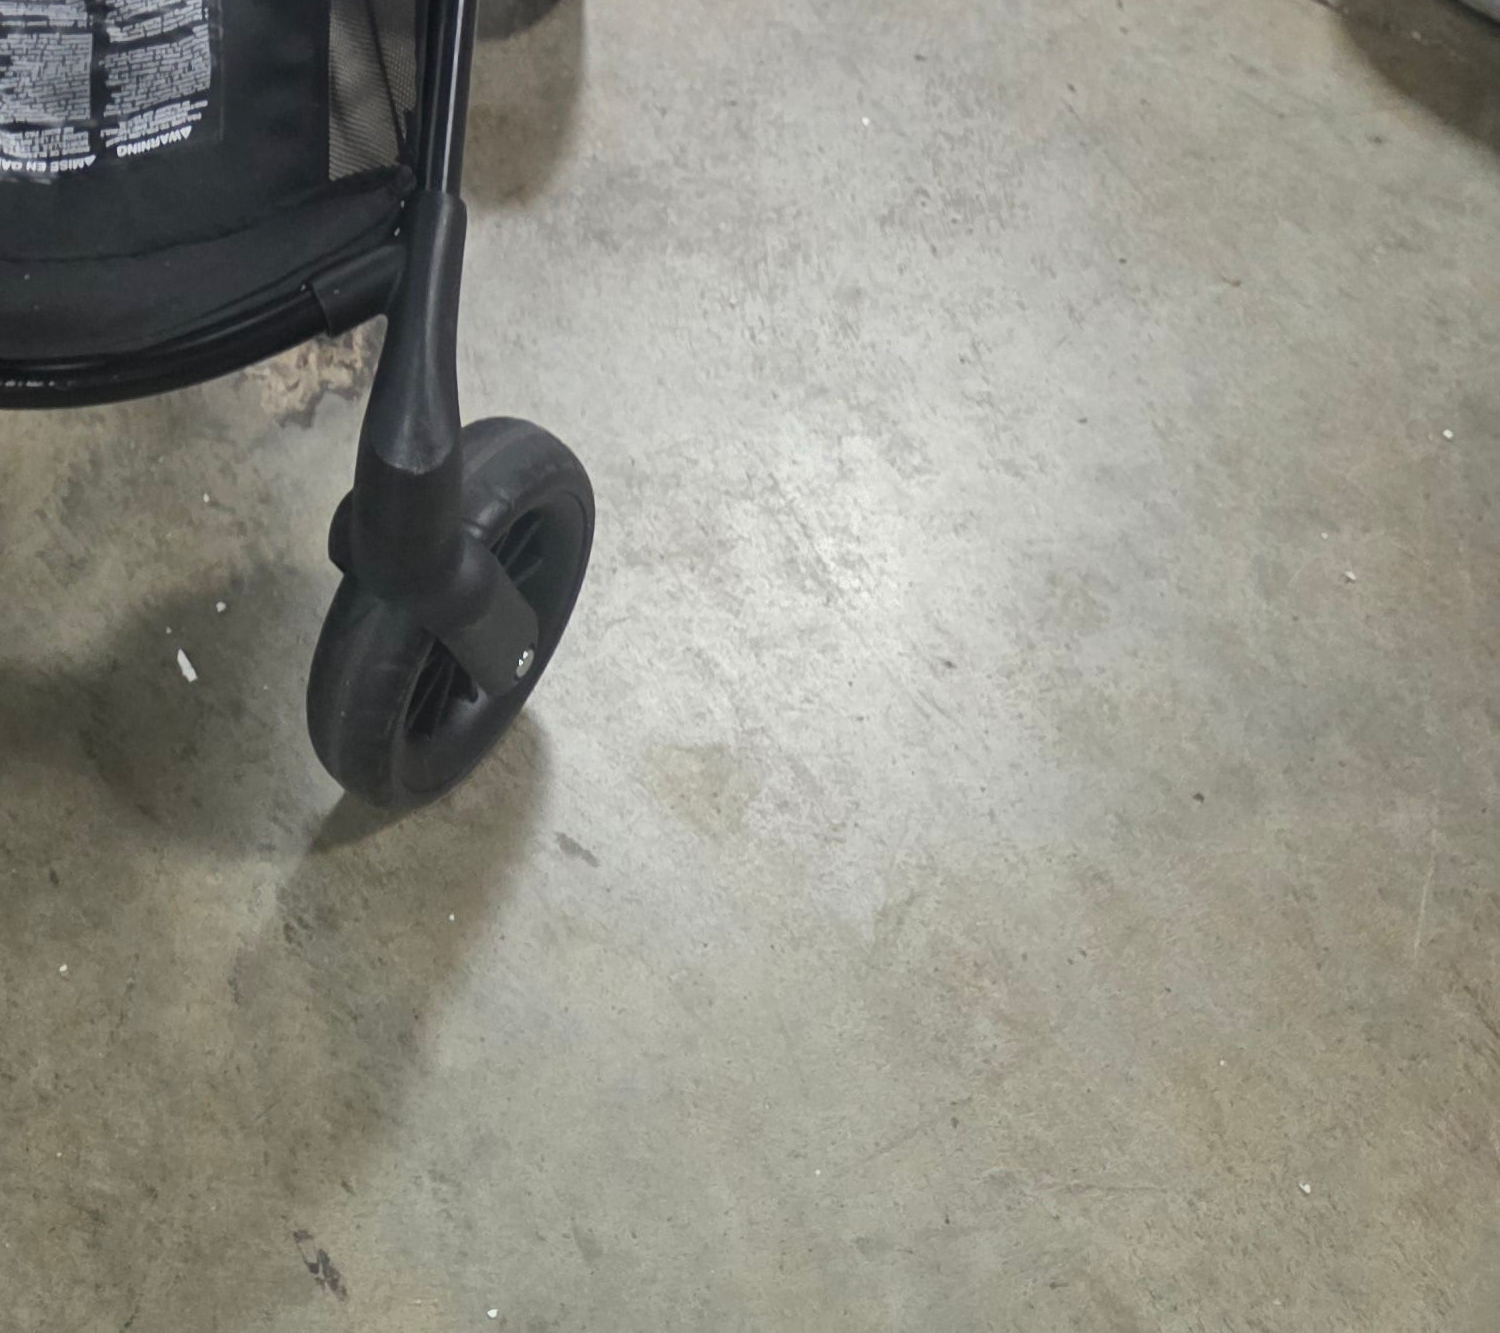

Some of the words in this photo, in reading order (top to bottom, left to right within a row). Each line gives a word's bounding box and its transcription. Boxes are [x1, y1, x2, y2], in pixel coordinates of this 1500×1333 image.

[116, 129, 180, 159] WARNING
[24, 159, 47, 174] EN
[50, 154, 84, 173] MISE
